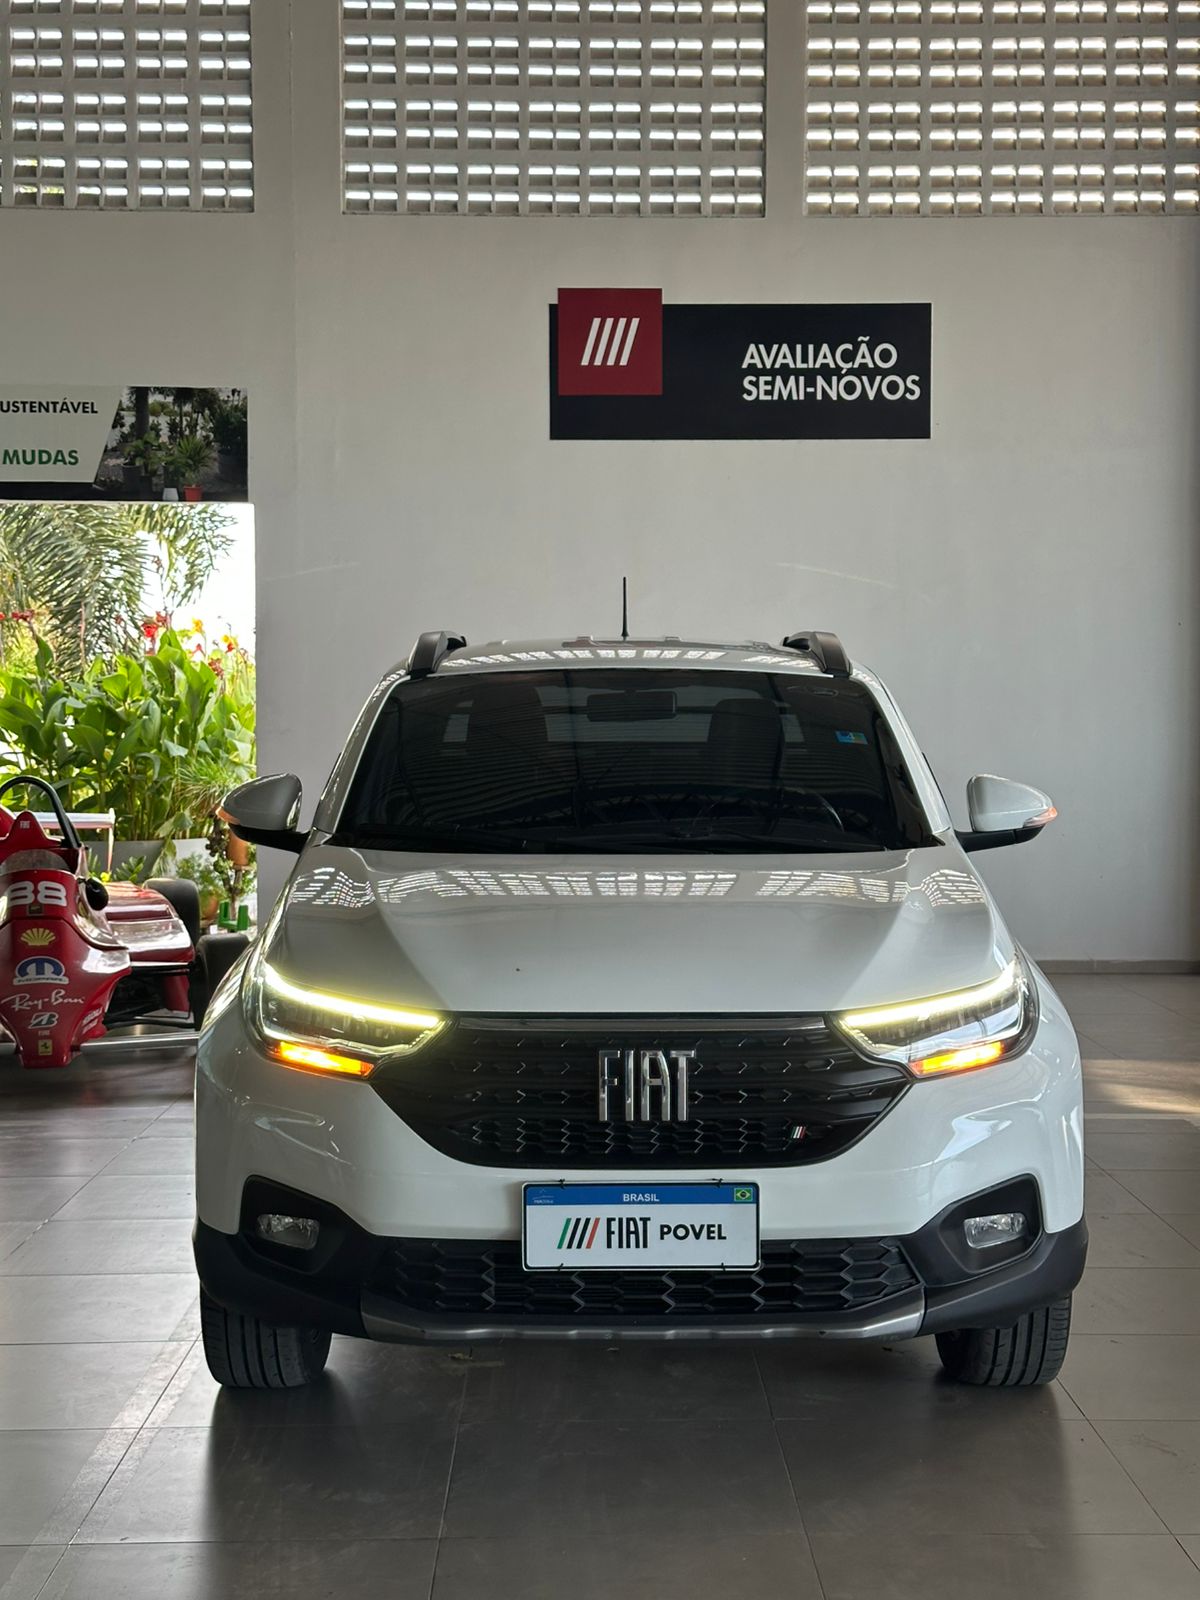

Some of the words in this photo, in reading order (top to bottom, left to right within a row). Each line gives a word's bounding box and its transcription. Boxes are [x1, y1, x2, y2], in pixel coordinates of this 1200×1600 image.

[741, 336, 898, 374] AVALIAÇÃO
[742, 374, 921, 401] SEMI-NOVOS
[2, 449, 79, 466] MUDAS
[0, 988, 85, 1011] Ray-Ban
[599, 1049, 696, 1121] FIAT
[622, 1193, 660, 1202] BRASIL
[605, 1216, 652, 1249] FIAT
[659, 1223, 727, 1241] POVEL
